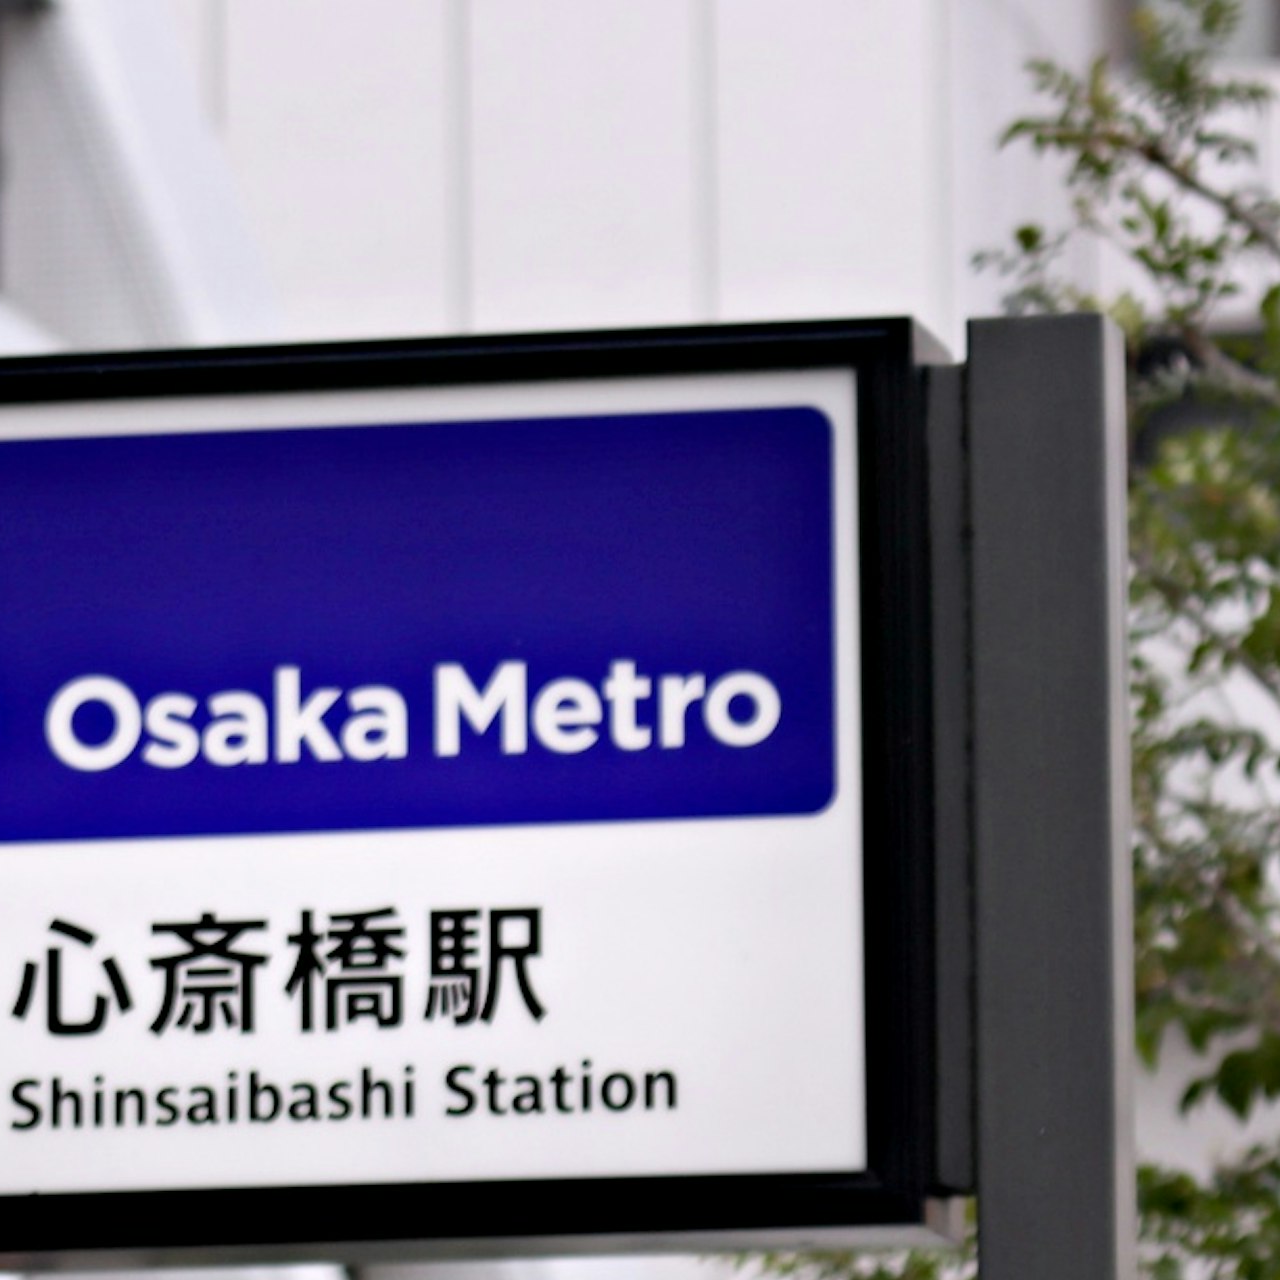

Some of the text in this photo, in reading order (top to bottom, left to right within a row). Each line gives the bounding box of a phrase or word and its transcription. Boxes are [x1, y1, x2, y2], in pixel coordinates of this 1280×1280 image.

[44, 658, 782, 773] Osaka Metro
[10, 905, 547, 1038] 心斎橋駅
[10, 1060, 679, 1132] Shinsaibashi Station
